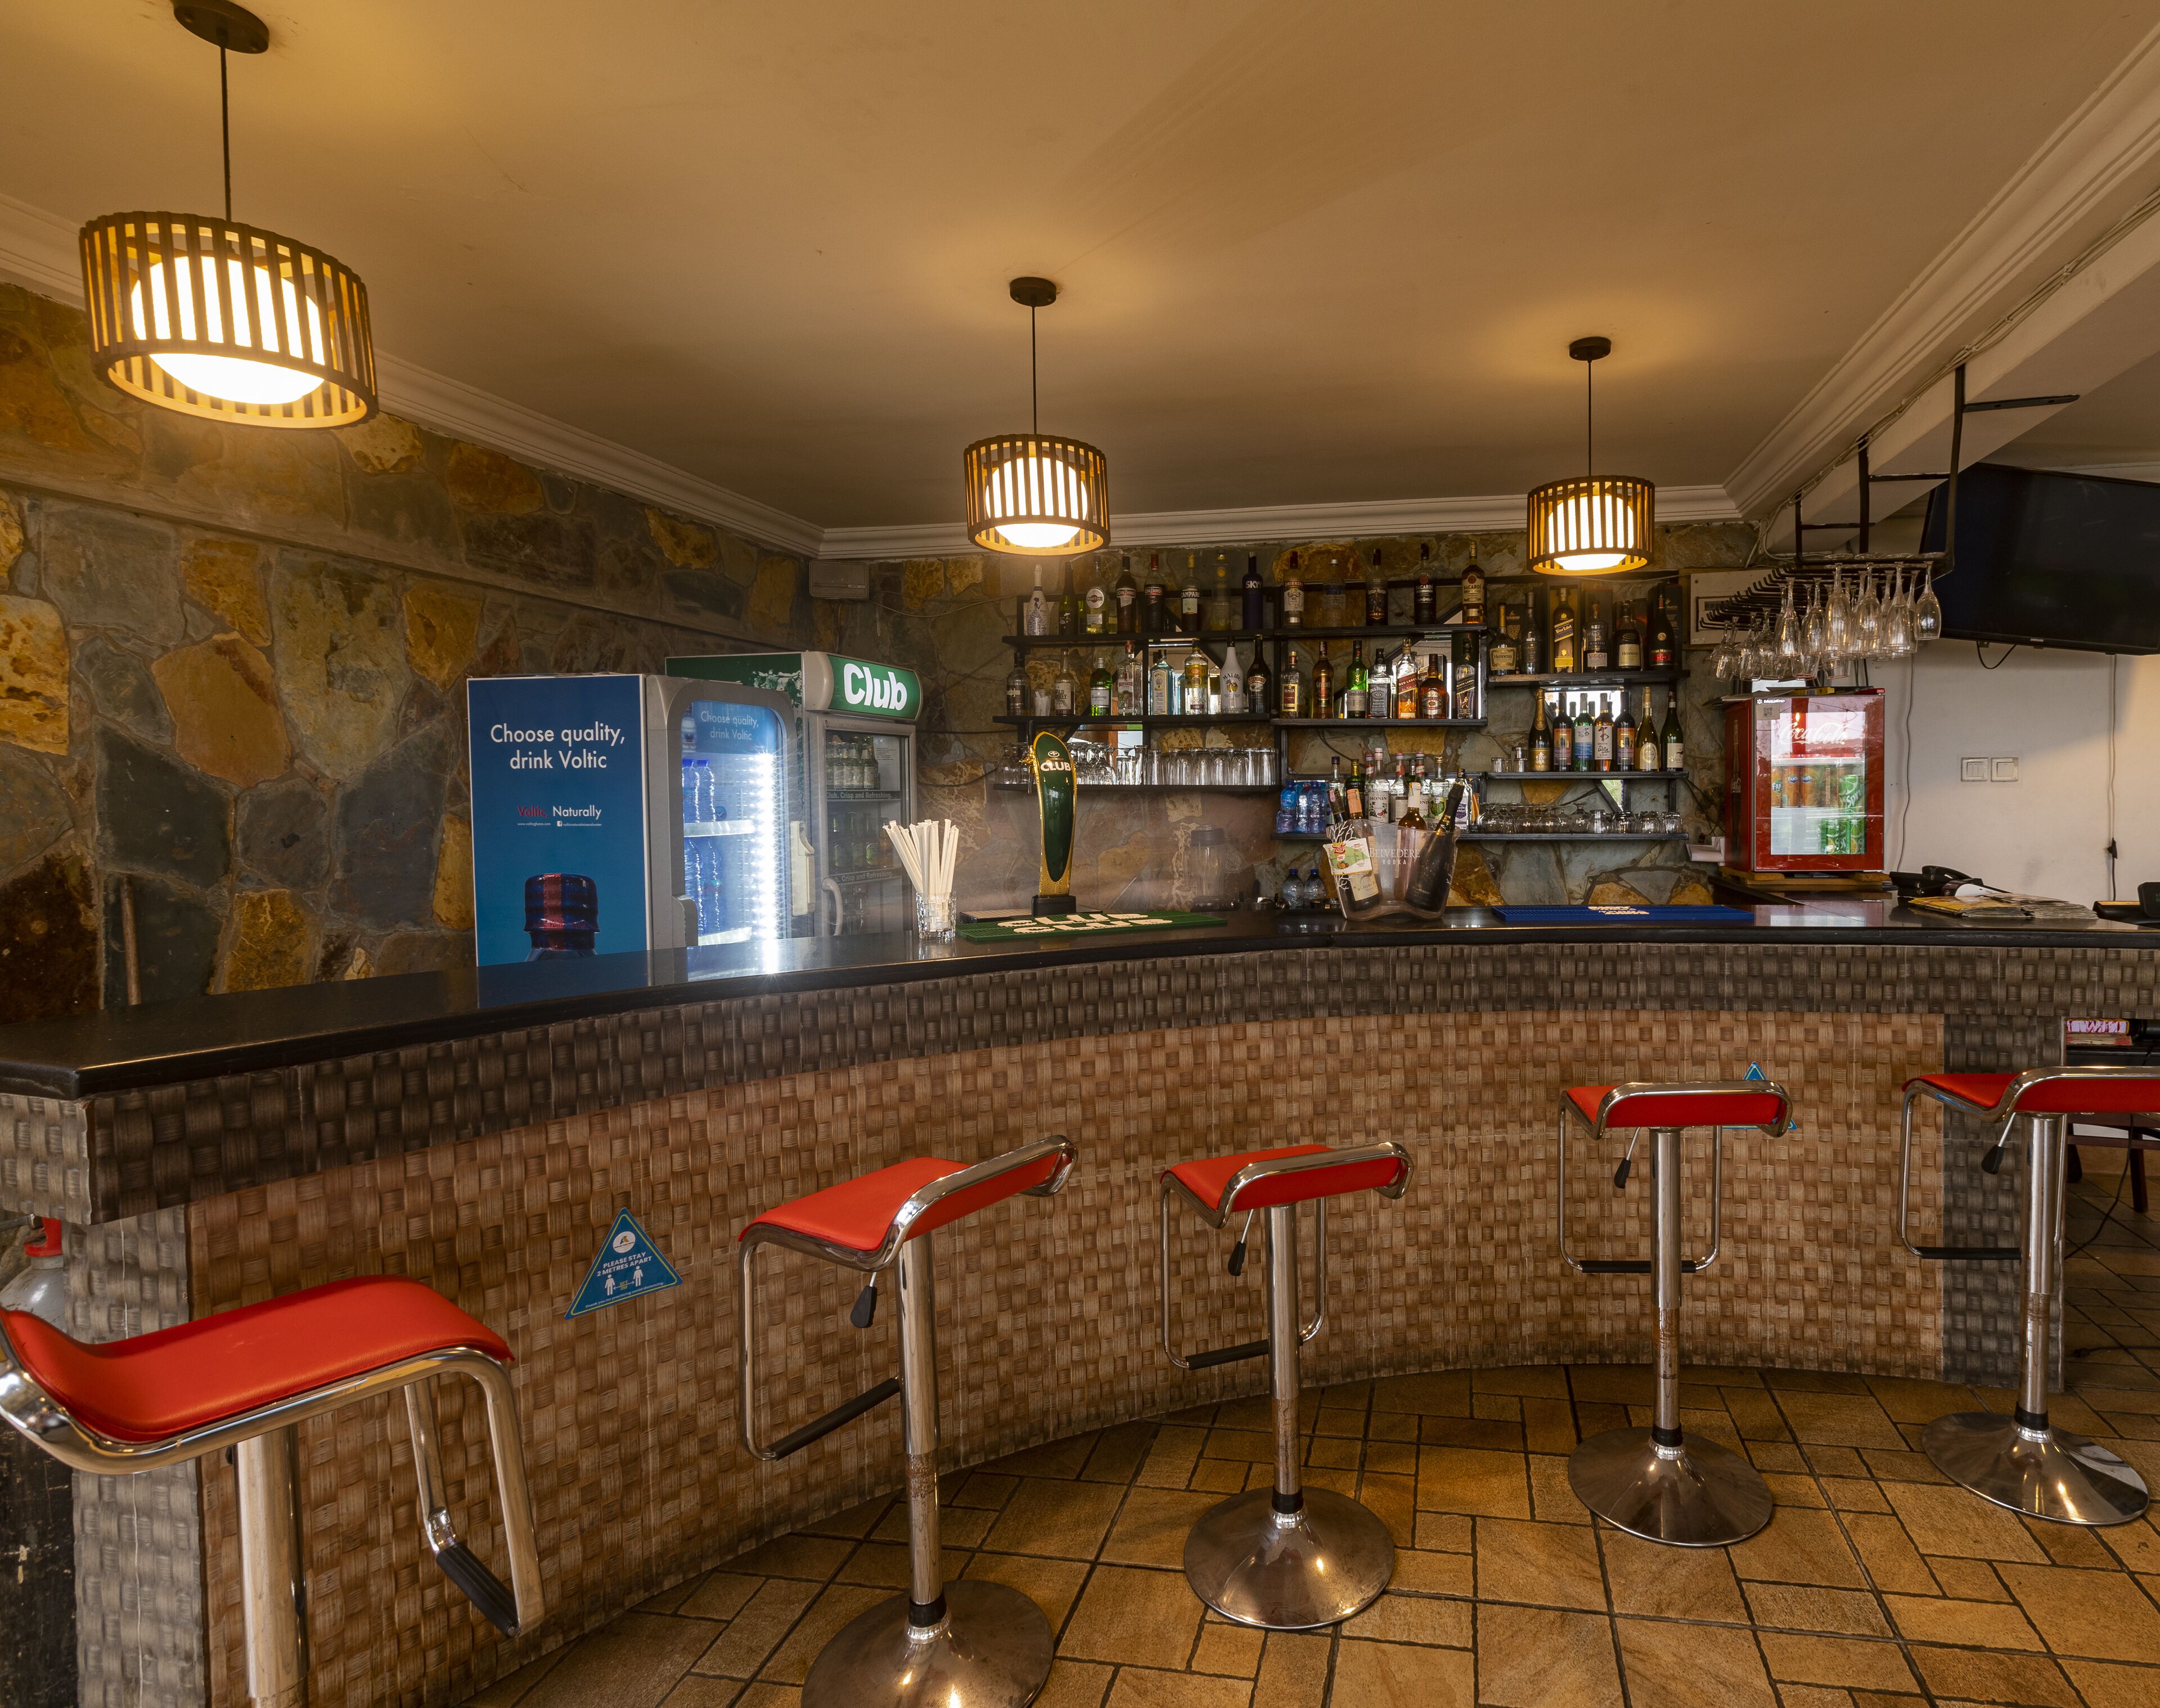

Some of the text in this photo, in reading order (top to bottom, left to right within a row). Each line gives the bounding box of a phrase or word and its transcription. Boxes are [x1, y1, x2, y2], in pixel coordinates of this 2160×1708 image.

[844, 663, 907, 711] Club
[701, 711, 759, 729] Choose quality,
[490, 721, 625, 747] Choose quality,
[710, 727, 752, 740] drink Voltic
[510, 748, 607, 770] drink Voltic
[1040, 761, 1072, 772] CLUB
[518, 804, 602, 820] Voltic, Naturally
[1369, 847, 1420, 859] BELVEDERE
[602, 1263, 629, 1275] METRES
[629, 1256, 652, 1267] APART
[603, 1251, 646, 1269] PLEASE STAY
